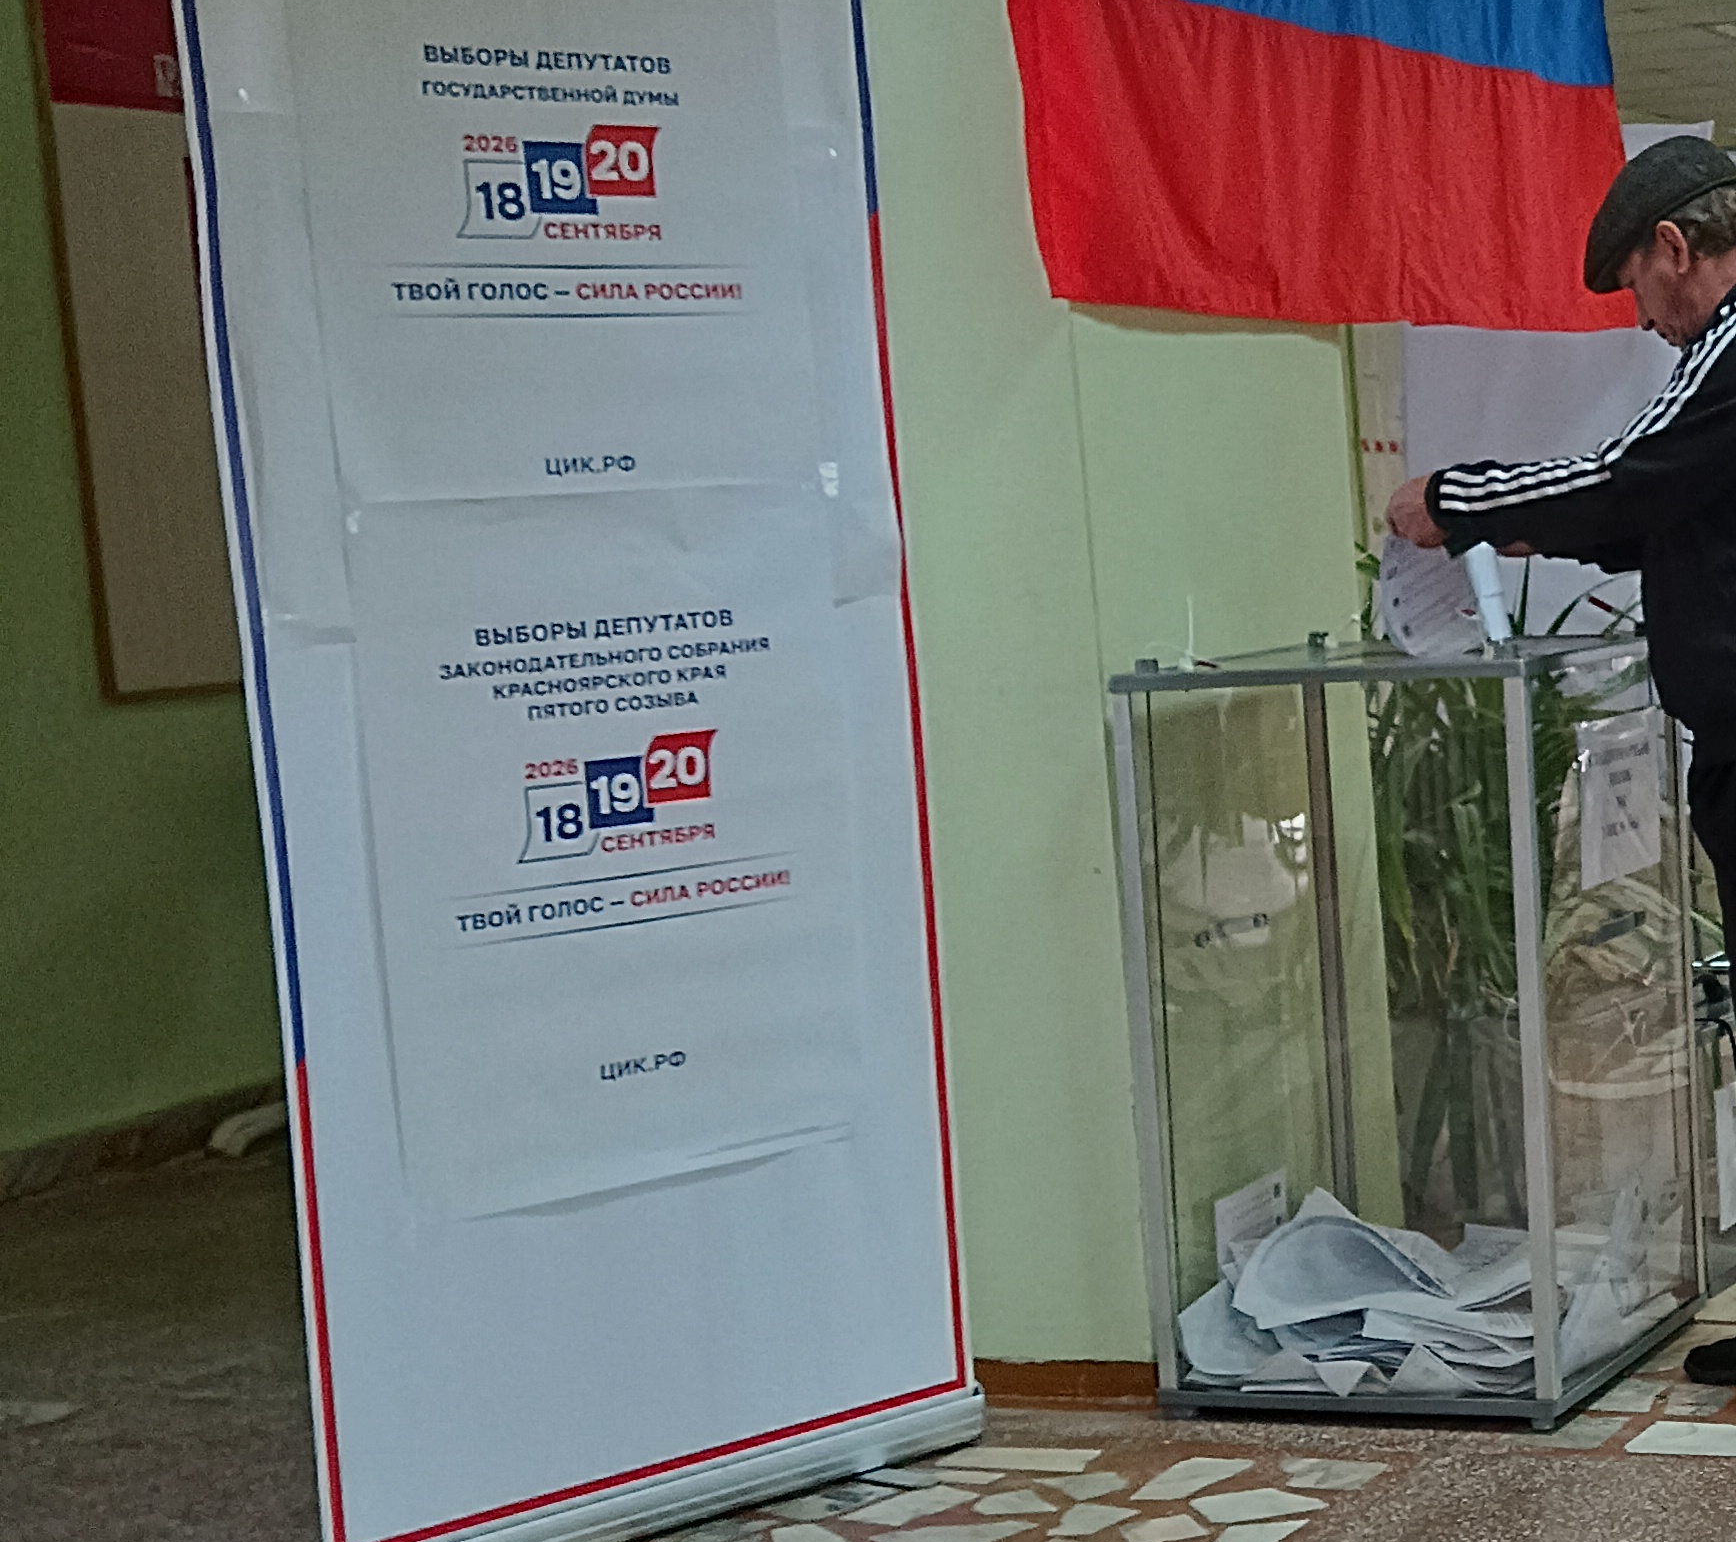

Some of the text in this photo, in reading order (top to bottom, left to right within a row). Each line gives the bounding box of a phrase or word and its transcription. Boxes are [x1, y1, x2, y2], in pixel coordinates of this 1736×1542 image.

[424, 44, 672, 75] ВЫБОРЫ ДЕПУТАТОВ
[422, 80, 680, 107] ГОСУДАРСТВЕННОЙ ДУМЫ
[463, 134, 518, 154] 2026
[475, 140, 651, 221] 18 19 20
[544, 222, 662, 241] СЕНТЯБРЯ
[392, 277, 461, 301] ТВОЙ
[468, 282, 547, 301] ГОЛОС
[576, 283, 638, 301] СИЛА
[644, 283, 742, 301] РОССИИ!
[545, 454, 636, 478] ЦИК.РФ
[475, 609, 734, 646] ВЫБОРЫ ДЕПУТАТОВ
[439, 636, 770, 680] ЗАКОНОДАТЕЛЬНОГО СОБРАНИЯ
[492, 664, 727, 699] КРАСНОЯРСКОГО КРАЯ
[527, 691, 699, 721] ПЯТОГО СОЗЫВА
[525, 759, 578, 779] 2026
[536, 747, 706, 843] 18 19 20
[601, 824, 716, 853] СЕНТЯБРЯ
[457, 903, 522, 932] ТВОЙ
[528, 897, 604, 922] ГОЛОС
[631, 885, 690, 908] СИЛА
[697, 870, 791, 898] РОССИИ!
[600, 1050, 687, 1082] ЦИК.РФ
